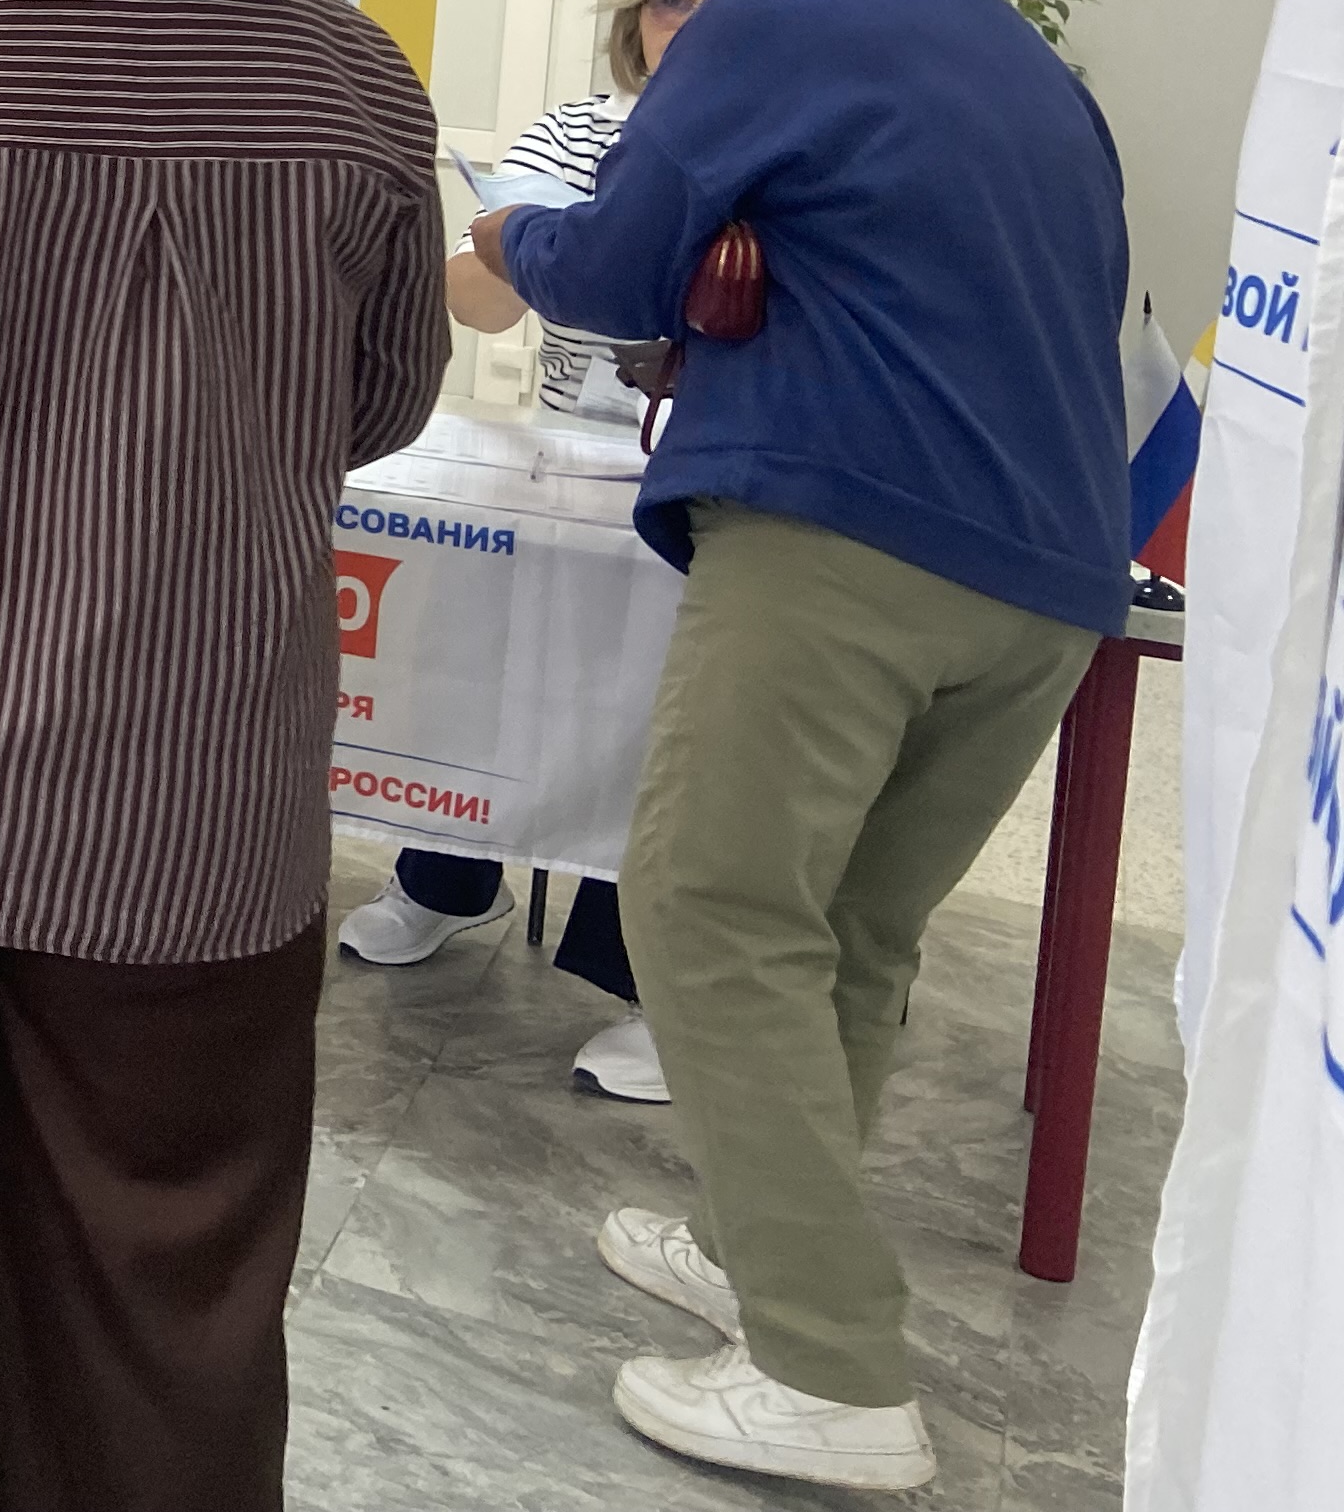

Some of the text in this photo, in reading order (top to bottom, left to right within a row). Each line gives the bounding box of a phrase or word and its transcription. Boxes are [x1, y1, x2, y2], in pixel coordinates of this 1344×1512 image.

[1222, 264, 1300, 344] ВОЙ
[335, 505, 515, 556] СОВАНИЯ
[329, 766, 491, 825] РОССИИ!
